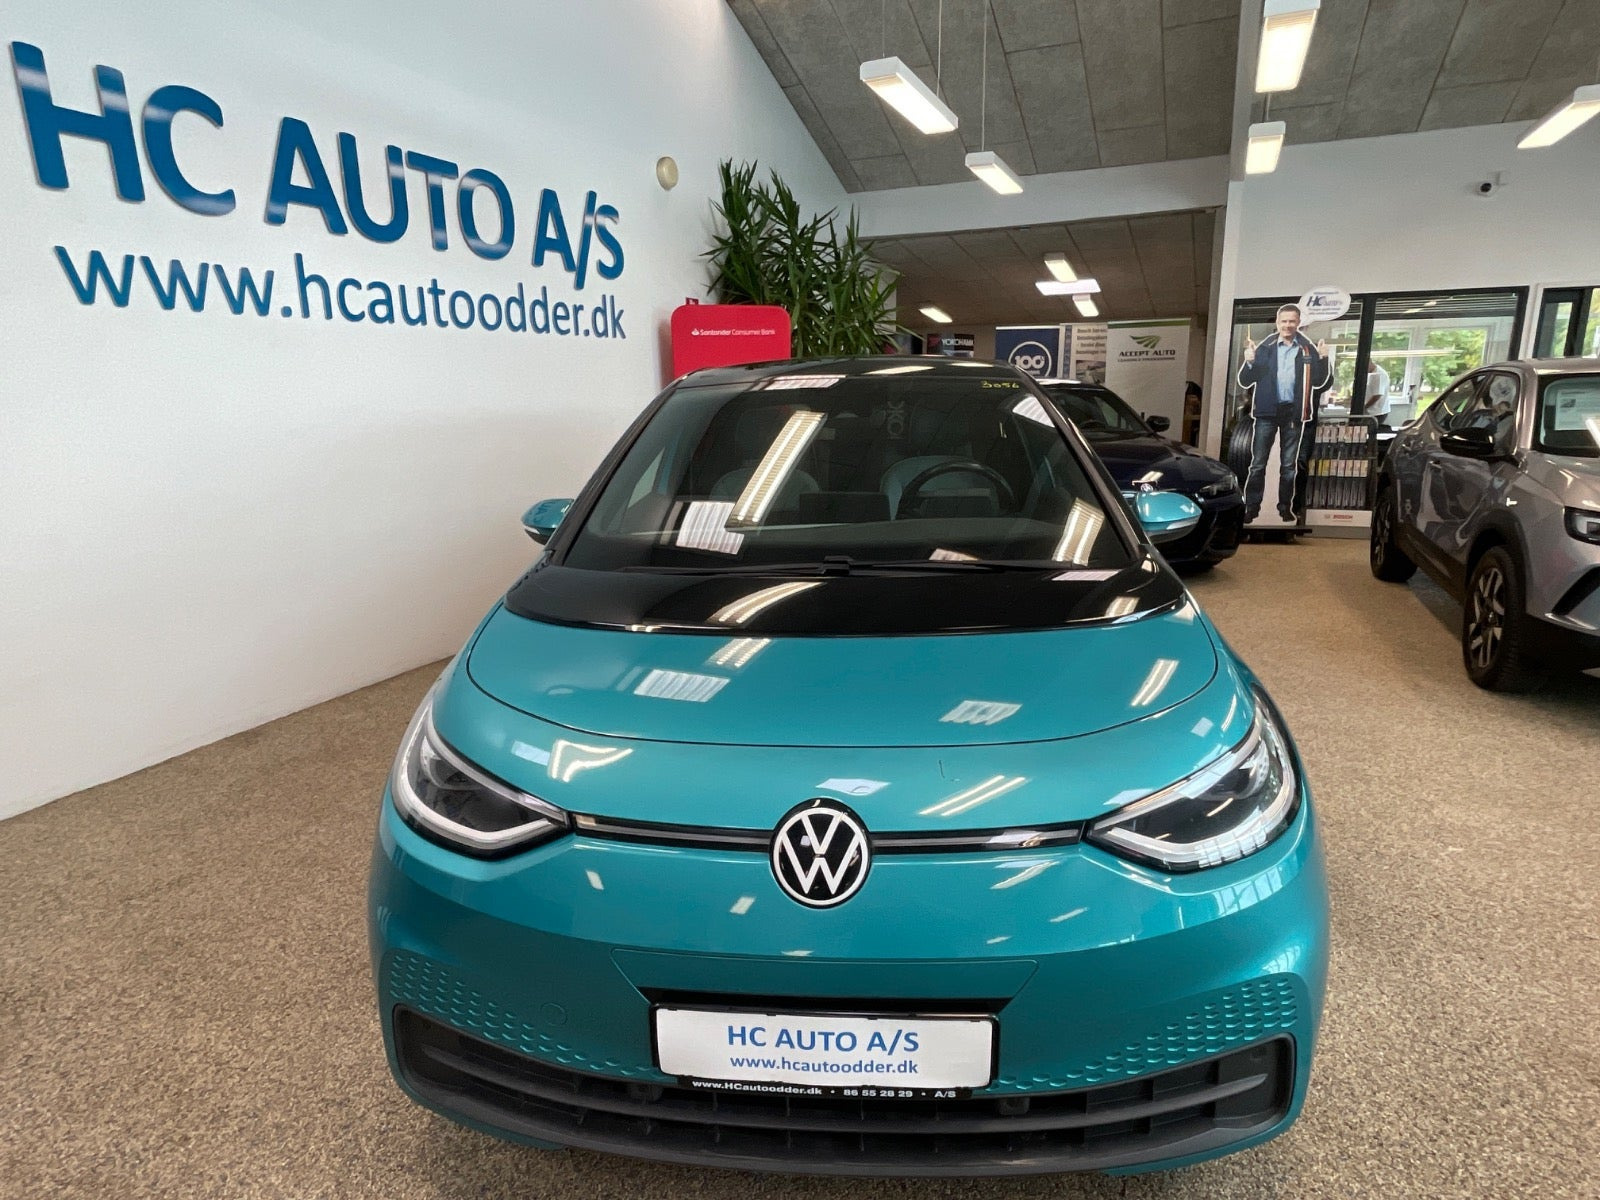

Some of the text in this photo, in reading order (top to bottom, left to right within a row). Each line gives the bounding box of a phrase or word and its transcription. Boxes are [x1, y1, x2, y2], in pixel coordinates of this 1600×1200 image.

[11, 40, 625, 290] HC AUTO A/S
[53, 245, 626, 340] www.hcautoodder.dk
[700, 328, 731, 336] Santander
[727, 1025, 920, 1056] HC AUTO A/S
[730, 1056, 919, 1074] www.hcautoodder.dk
[692, 1080, 822, 1095] www.HCautoodder.dk
[861, 1089, 877, 1097] 55
[898, 1090, 913, 1098] 29
[934, 1090, 957, 1098] A/S
